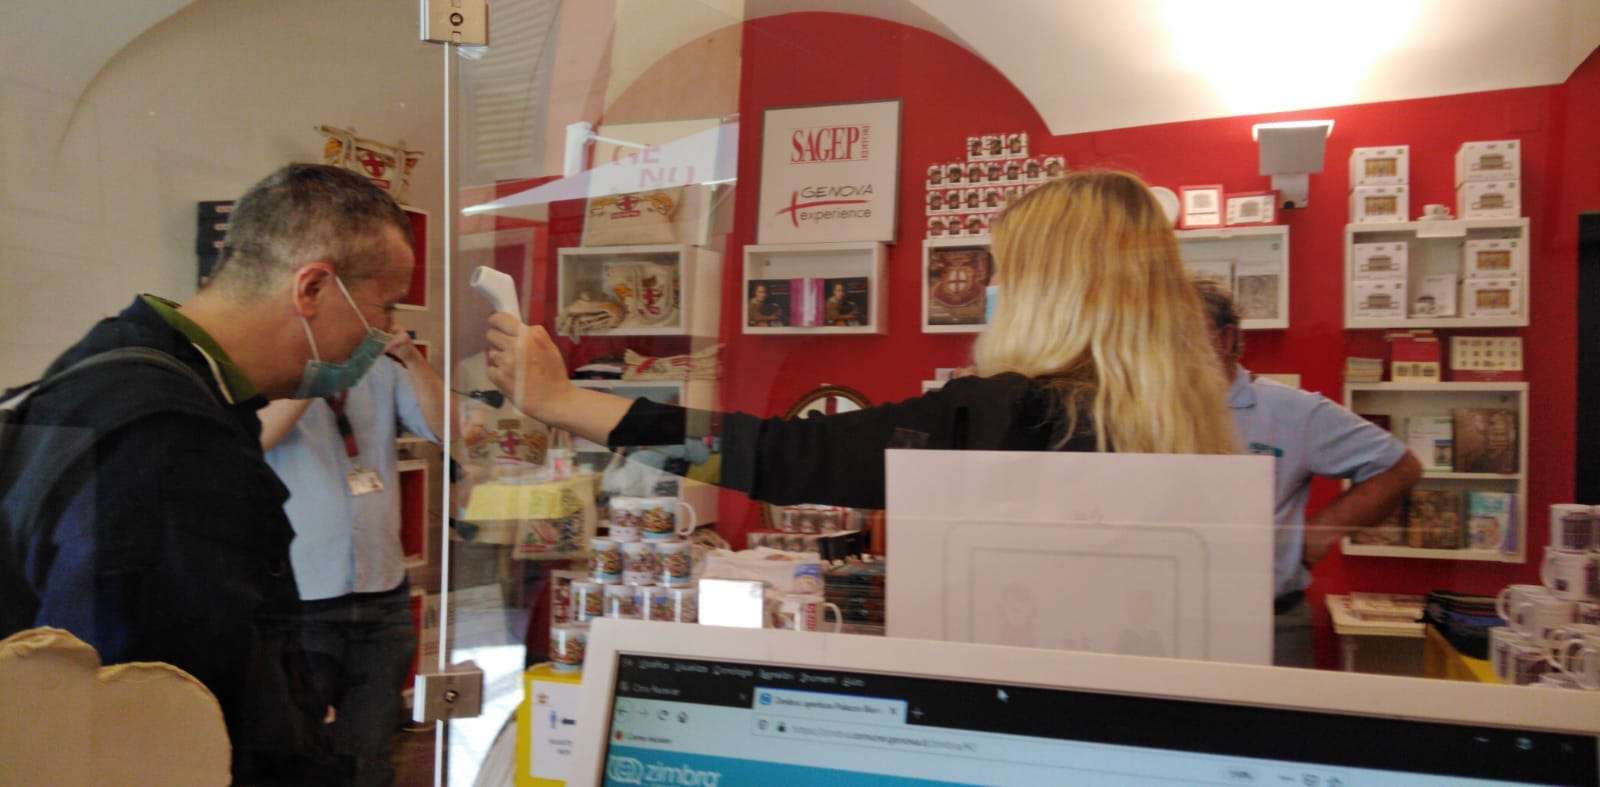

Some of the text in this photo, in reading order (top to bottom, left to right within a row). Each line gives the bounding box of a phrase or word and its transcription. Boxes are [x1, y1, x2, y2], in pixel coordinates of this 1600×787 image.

[791, 126, 860, 162] SAGEP
[800, 184, 874, 199] GENOVA
[800, 208, 872, 223] experience
